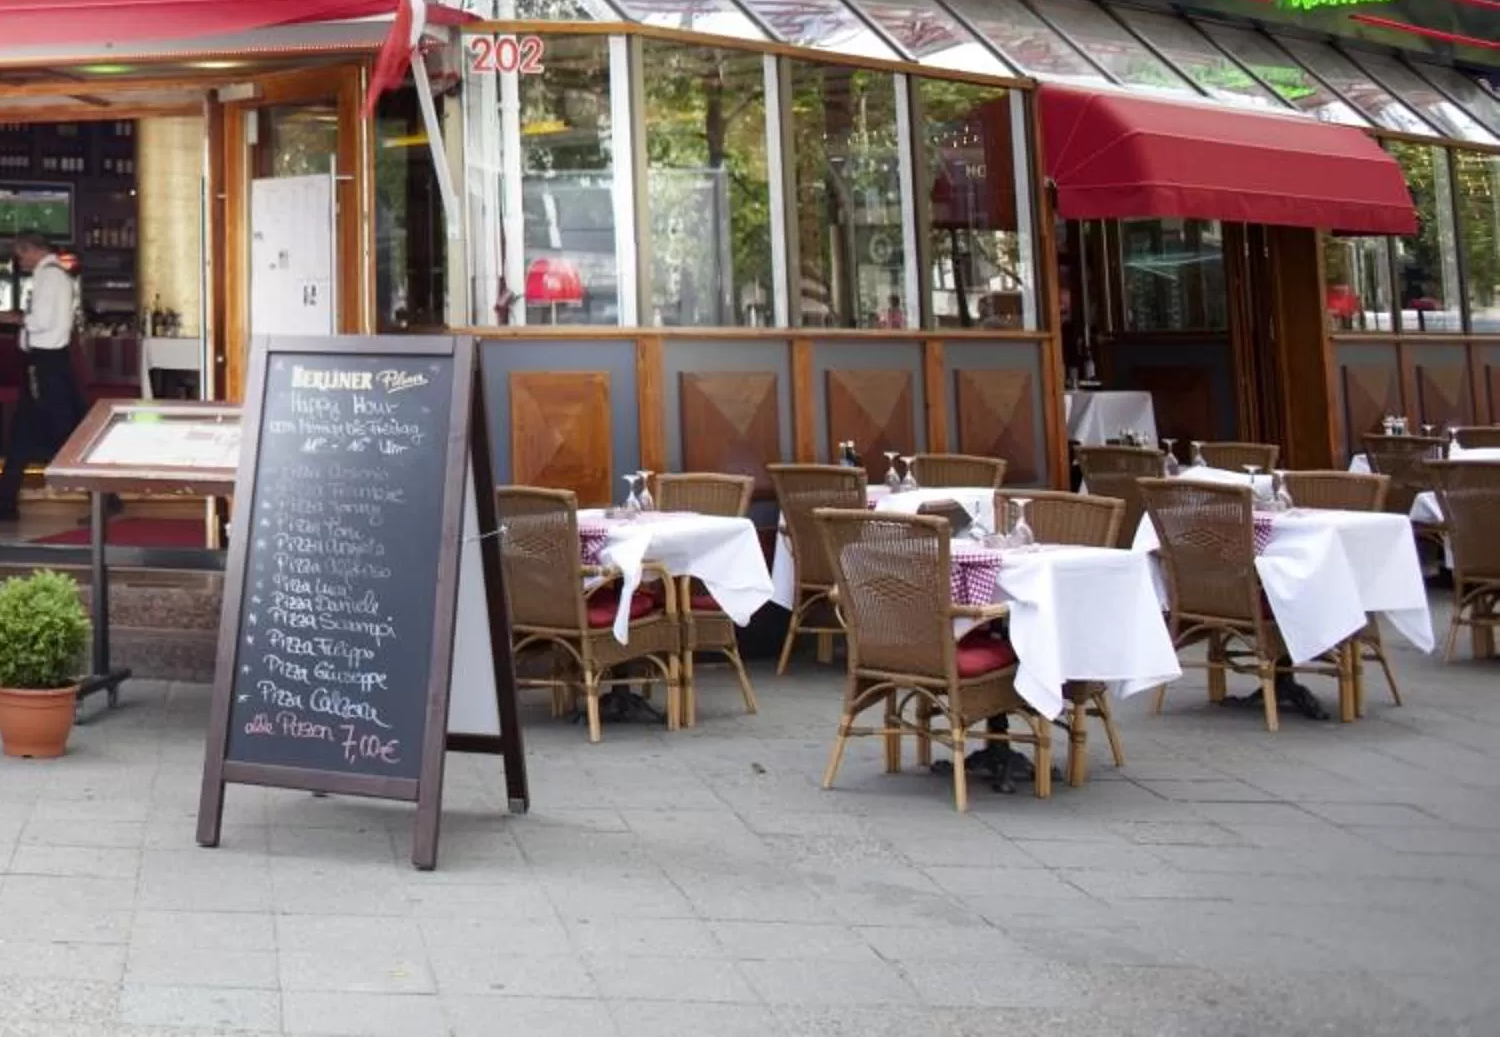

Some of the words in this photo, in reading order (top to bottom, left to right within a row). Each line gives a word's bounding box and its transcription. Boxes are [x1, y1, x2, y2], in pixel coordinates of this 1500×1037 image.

[470, 34, 545, 75] 202
[291, 365, 373, 391] BERLINER
[353, 393, 399, 415] Hour
[266, 605, 318, 630] Pizza
[265, 628, 316, 656] Pizza
[263, 653, 312, 685] Pizza
[256, 679, 305, 710] Pizza
